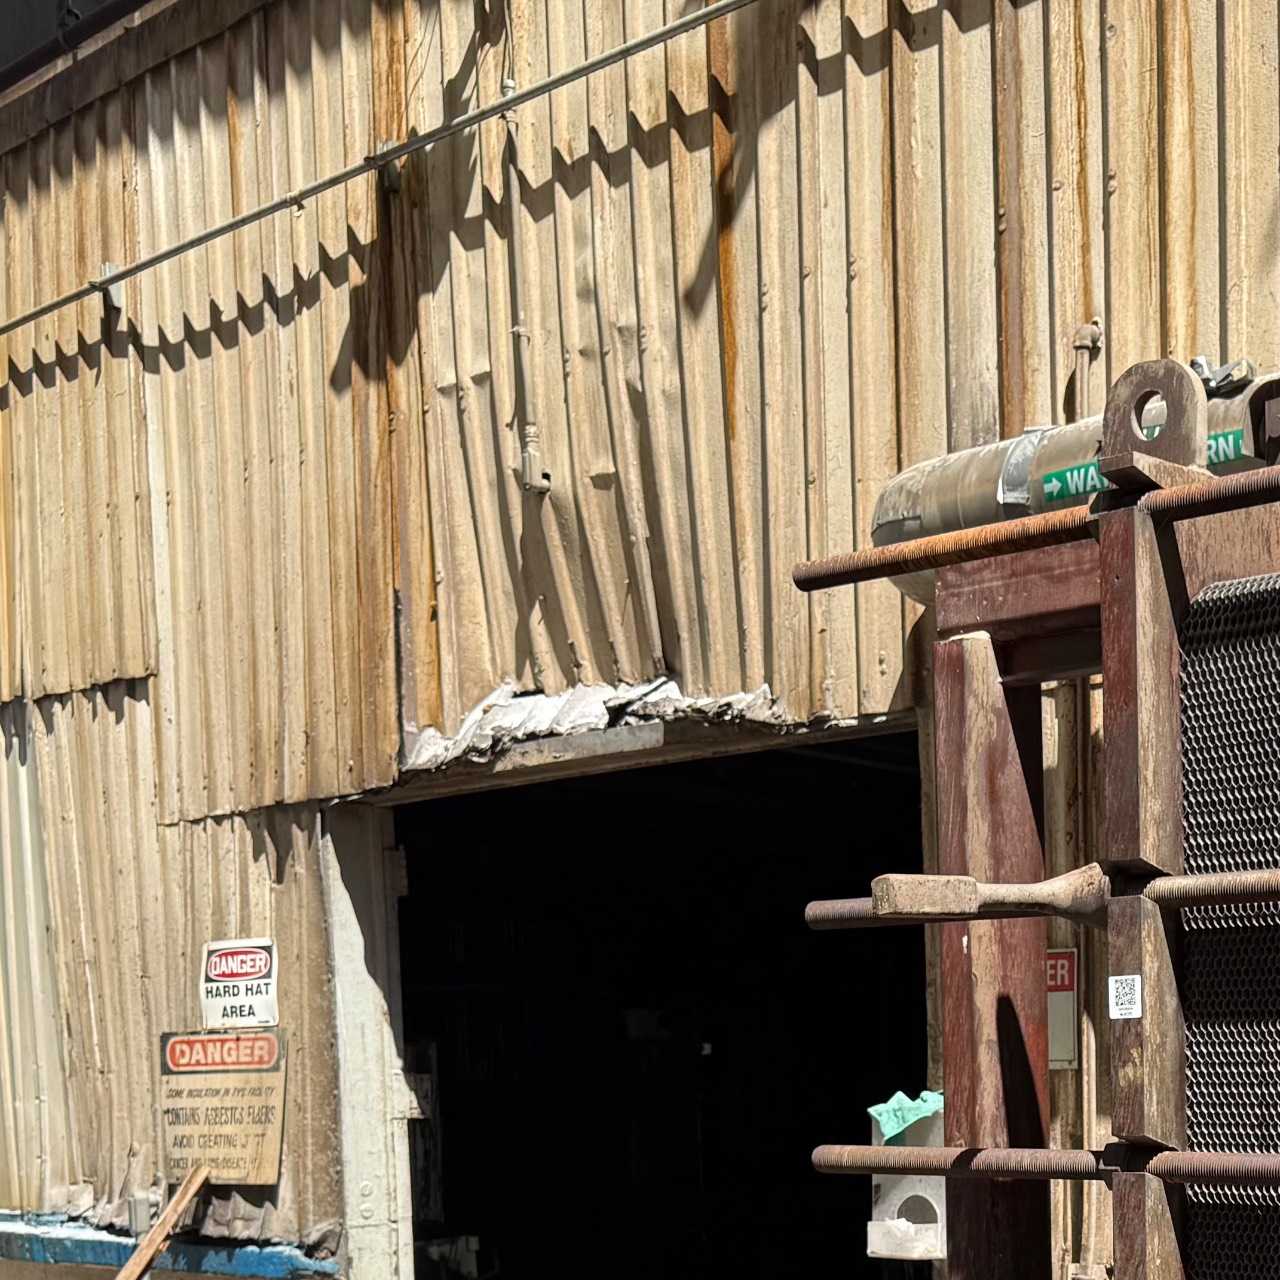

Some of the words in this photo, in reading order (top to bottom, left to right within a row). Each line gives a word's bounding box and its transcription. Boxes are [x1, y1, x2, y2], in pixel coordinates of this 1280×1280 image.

[211, 952, 267, 975] DANGER
[1046, 959, 1069, 986] ER
[205, 984, 240, 999] HARD
[245, 982, 271, 997] HAT
[222, 1004, 256, 1018] AREA
[174, 1039, 270, 1065] DANGER
